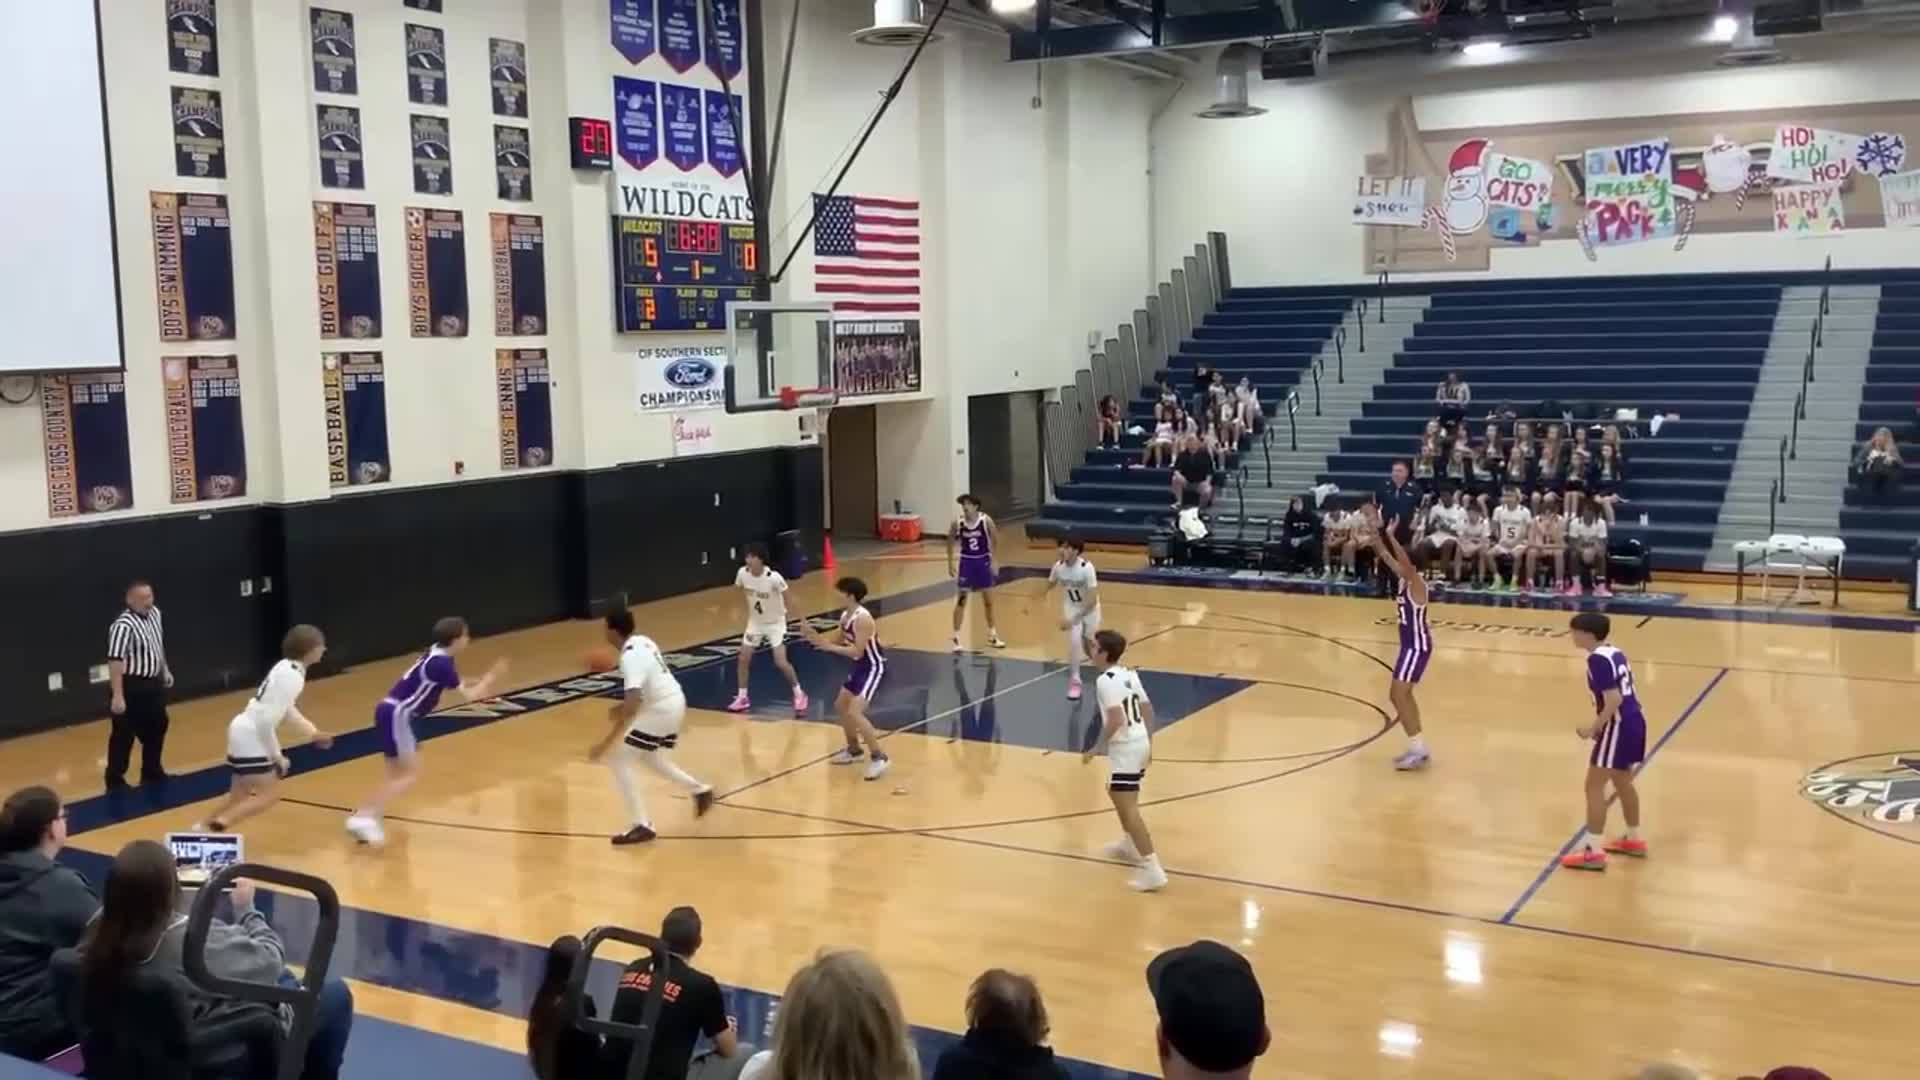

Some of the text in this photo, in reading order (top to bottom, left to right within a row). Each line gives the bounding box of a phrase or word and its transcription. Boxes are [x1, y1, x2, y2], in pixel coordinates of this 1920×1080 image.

[1782, 127, 1815, 147] HO!
[1499, 157, 1531, 180] GO
[1615, 141, 1669, 175] VERY
[1791, 143, 1827, 168] HO!
[1811, 158, 1849, 182] HO!
[1359, 176, 1394, 197] LET
[1775, 189, 1833, 211] HAPPY
[621, 185, 755, 222] WILDCATS
[645, 238, 657, 267] 5
[744, 243, 756, 270] 0
[156, 215, 183, 337] BOYS SWIMMING
[316, 226, 336, 335] BOYS GOLF
[410, 232, 427, 333] BOYS SOCCER
[645, 298, 656, 320] 2
[655, 347, 701, 358] SOUTHERN
[674, 361, 708, 383] Ford
[44, 385, 67, 441] COUNTRY
[499, 367, 516, 466] BOYS TENNIS
[168, 383, 192, 500] BOYS VOLLEYBALL
[324, 377, 345, 482] BASEBALL
[51, 479, 73, 513] BOYS
[754, 600, 763, 615] 4
[1122, 693, 1142, 727] 10
